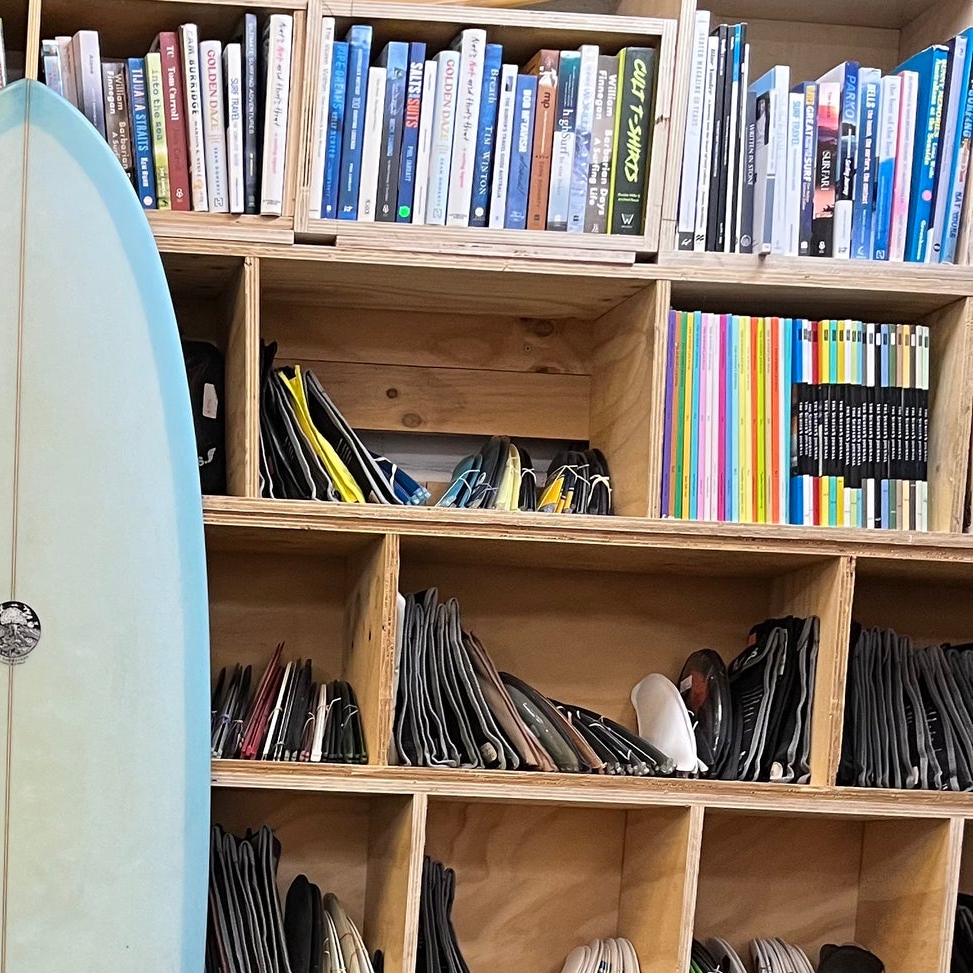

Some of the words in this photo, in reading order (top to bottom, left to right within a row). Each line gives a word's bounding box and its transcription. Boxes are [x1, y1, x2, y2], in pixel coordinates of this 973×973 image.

[166, 45, 175, 59] TC
[131, 67, 145, 112] TIJUANA
[150, 68, 161, 95] into
[167, 66, 176, 87] Tom
[190, 58, 201, 116] BURRIDGE
[208, 49, 220, 100] GOLDEN
[230, 77, 240, 96] SURF
[332, 70, 346, 110] DREAMS
[408, 61, 423, 94] SALTS
[441, 59, 456, 108] GOLDEN
[488, 68, 500, 104] Breath
[630, 58, 648, 103] CULT
[106, 70, 117, 115] Finnegan
[114, 73, 124, 111] William
[168, 87, 179, 121] Carroll
[522, 88, 533, 109] BOB
[541, 91, 552, 109] mp
[595, 70, 608, 120] Finnegan
[606, 74, 618, 117] William
[845, 74, 857, 119] PARKO
[865, 83, 877, 109] BELLS
[152, 98, 161, 119] the
[210, 100, 220, 130] DAZE
[231, 97, 240, 122] TRAVEL
[247, 88, 255, 135] ADVENTURES
[406, 98, 420, 129] SUITS
[791, 100, 801, 120] SURF
[804, 105, 814, 137] GREAT
[135, 113, 149, 152] STRAITS
[155, 121, 164, 142] sea
[440, 109, 451, 142] DAZE
[483, 125, 493, 145] TIM
[593, 137, 602, 146] A
[747, 123, 756, 154] WRITTEN
[790, 121, 800, 147] TRAVEL
[118, 121, 130, 170] Barbarian
[599, 129, 613, 185] Barbarian
[624, 104, 644, 183] T-SHIRTS
[747, 154, 755, 164] IN
[478, 150, 492, 195] WINTON
[588, 147, 602, 185] Surfing
[746, 164, 754, 186] STONE
[802, 156, 812, 182] SURF
[820, 150, 832, 191] SURFARI
[588, 186, 598, 206] Life
[597, 187, 609, 216] Days
[953, 191, 963, 208] NAT
